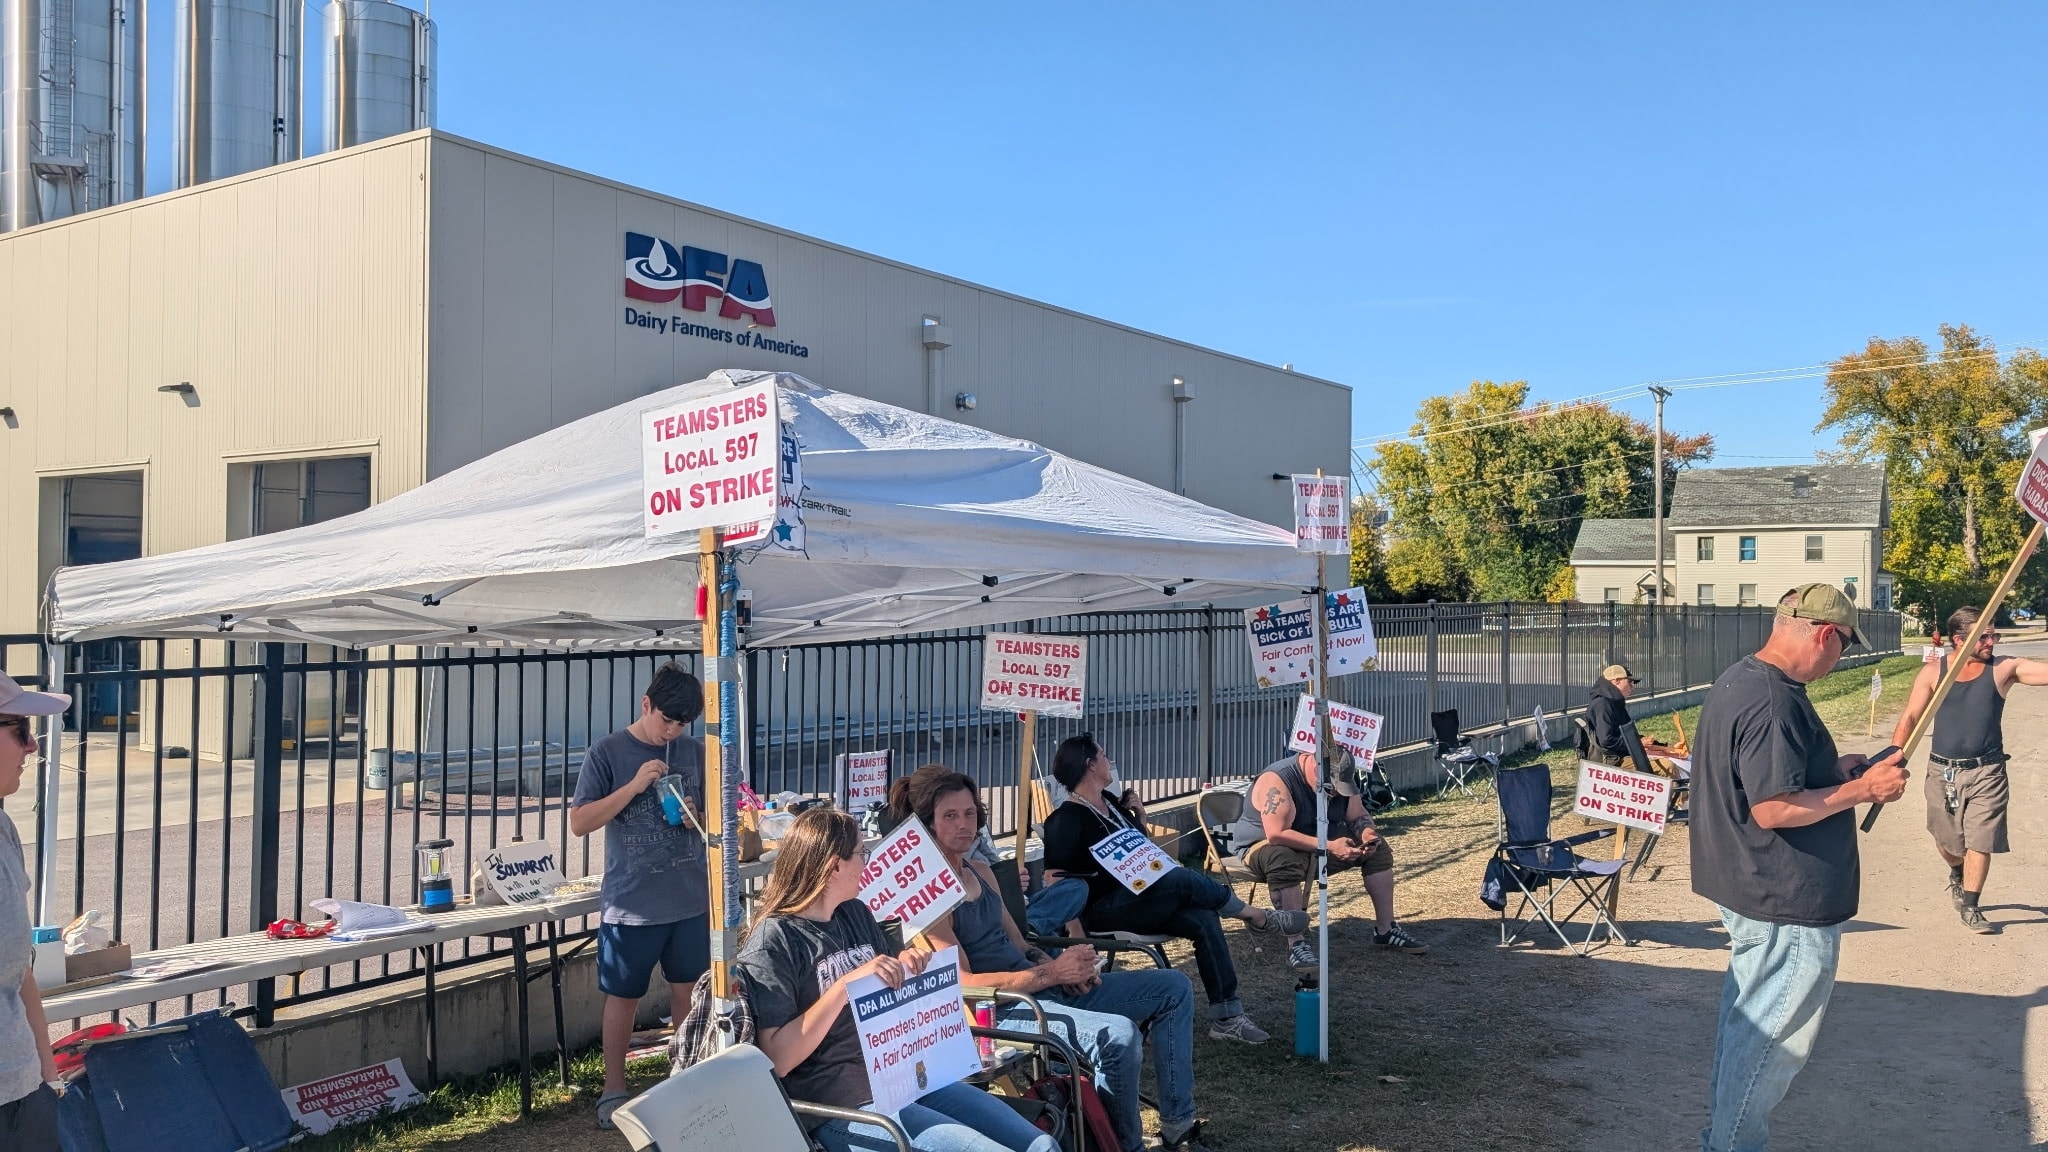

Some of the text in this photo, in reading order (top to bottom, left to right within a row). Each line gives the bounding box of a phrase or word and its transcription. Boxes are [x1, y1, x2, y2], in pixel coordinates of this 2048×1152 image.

[625, 231, 776, 327] DFA
[625, 307, 809, 358] Dairy Farmers of America
[653, 392, 767, 442] TEAMSTERS
[664, 432, 758, 475] LOCAL 597
[651, 487, 681, 516] ON
[689, 467, 774, 508] STRIKE
[1298, 483, 1344, 498] TEAMSTERS
[1327, 504, 1340, 518] 597
[1297, 525, 1348, 540] ON STRIKE
[1253, 602, 1361, 632] DFA TEAMSS ARE
[1260, 630, 1286, 644] SICK
[1289, 627, 1303, 637] OF
[1329, 616, 1360, 631] BULL
[996, 640, 1080, 659] TEAMSTERS
[1262, 633, 1366, 661] Fair Contrt Now!
[1002, 660, 1071, 678] LOCAL 597
[988, 680, 1082, 702] ON STRIKE
[1308, 701, 1377, 730] TMSTERS
[1296, 730, 1316, 745] ON
[1345, 727, 1367, 742] 597
[848, 756, 888, 769] TEAMSTER
[852, 772, 875, 783] LOCAL
[1588, 767, 1664, 793] TEAMSTERS
[863, 785, 888, 797] STRIK
[1593, 783, 1655, 806] LOCAL 597
[1580, 796, 1664, 824] ON STRIKE
[484, 853, 504, 871] IN
[858, 829, 922, 892] MSTERS
[1098, 841, 1116, 857] THE
[496, 854, 555, 881] SOLIDARITY
[894, 856, 926, 889] 597
[1124, 872, 1133, 881] A
[1131, 861, 1147, 875] Fair
[884, 868, 957, 923] TRIKE
[859, 1001, 878, 1016] DFA
[879, 994, 895, 1010] ALL
[894, 983, 918, 1003] WORK
[923, 977, 937, 991] NO
[938, 968, 956, 985] PAY!
[866, 1016, 916, 1049] Teamsters
[916, 996, 960, 1027] Demand
[873, 1057, 882, 1074] A
[883, 1047, 900, 1069] Fair
[901, 1029, 938, 1059] Contract
[940, 1018, 966, 1040] Now!
[303, 1067, 386, 1099] HARASSMENT!
[302, 1097, 329, 1112] AND
[328, 1093, 385, 1115] UNFAIR
